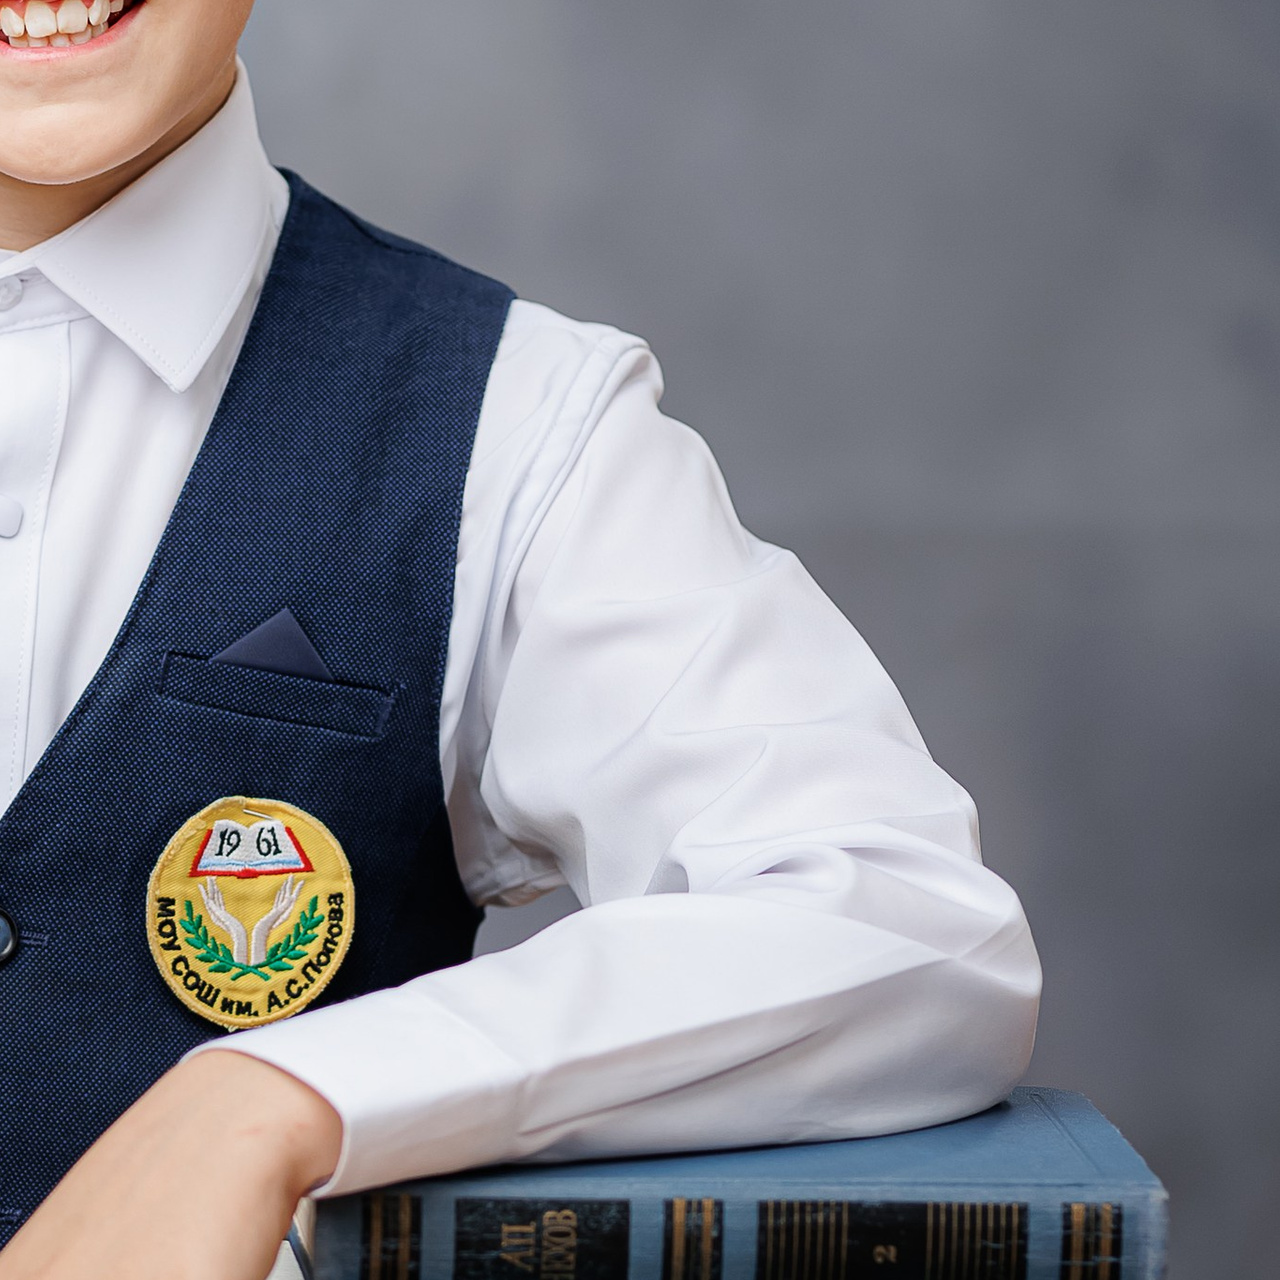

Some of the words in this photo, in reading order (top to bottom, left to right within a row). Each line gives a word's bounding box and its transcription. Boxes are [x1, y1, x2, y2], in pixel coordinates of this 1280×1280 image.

[215, 827, 241, 857] 19
[256, 826, 283, 857] 61
[157, 896, 181, 952] МОУ
[171, 955, 221, 1008] СОШ
[220, 997, 259, 1017] им.
